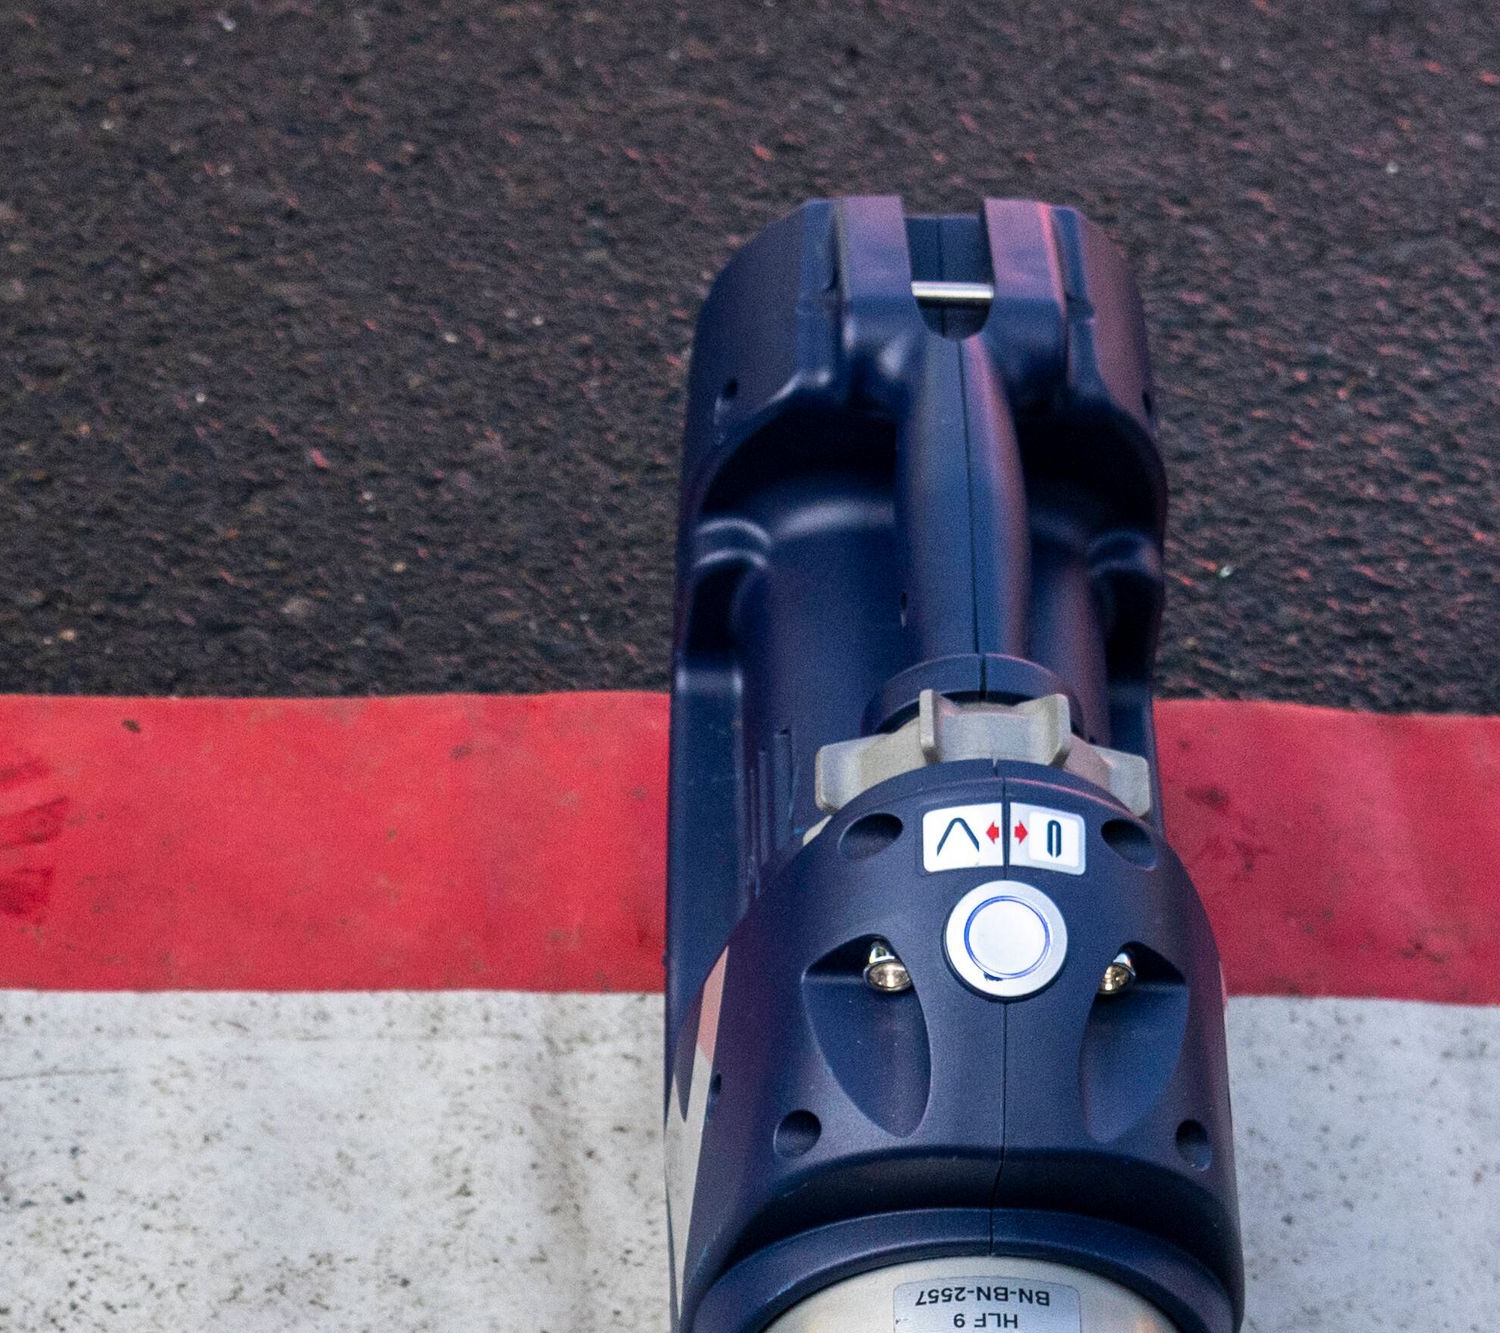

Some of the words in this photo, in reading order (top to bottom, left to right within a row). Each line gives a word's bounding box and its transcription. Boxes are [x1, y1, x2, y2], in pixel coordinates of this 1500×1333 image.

[915, 1286, 1050, 1307] BN-BN-2557
[953, 1313, 966, 1329] 9
[974, 1313, 1018, 1329] HLF
